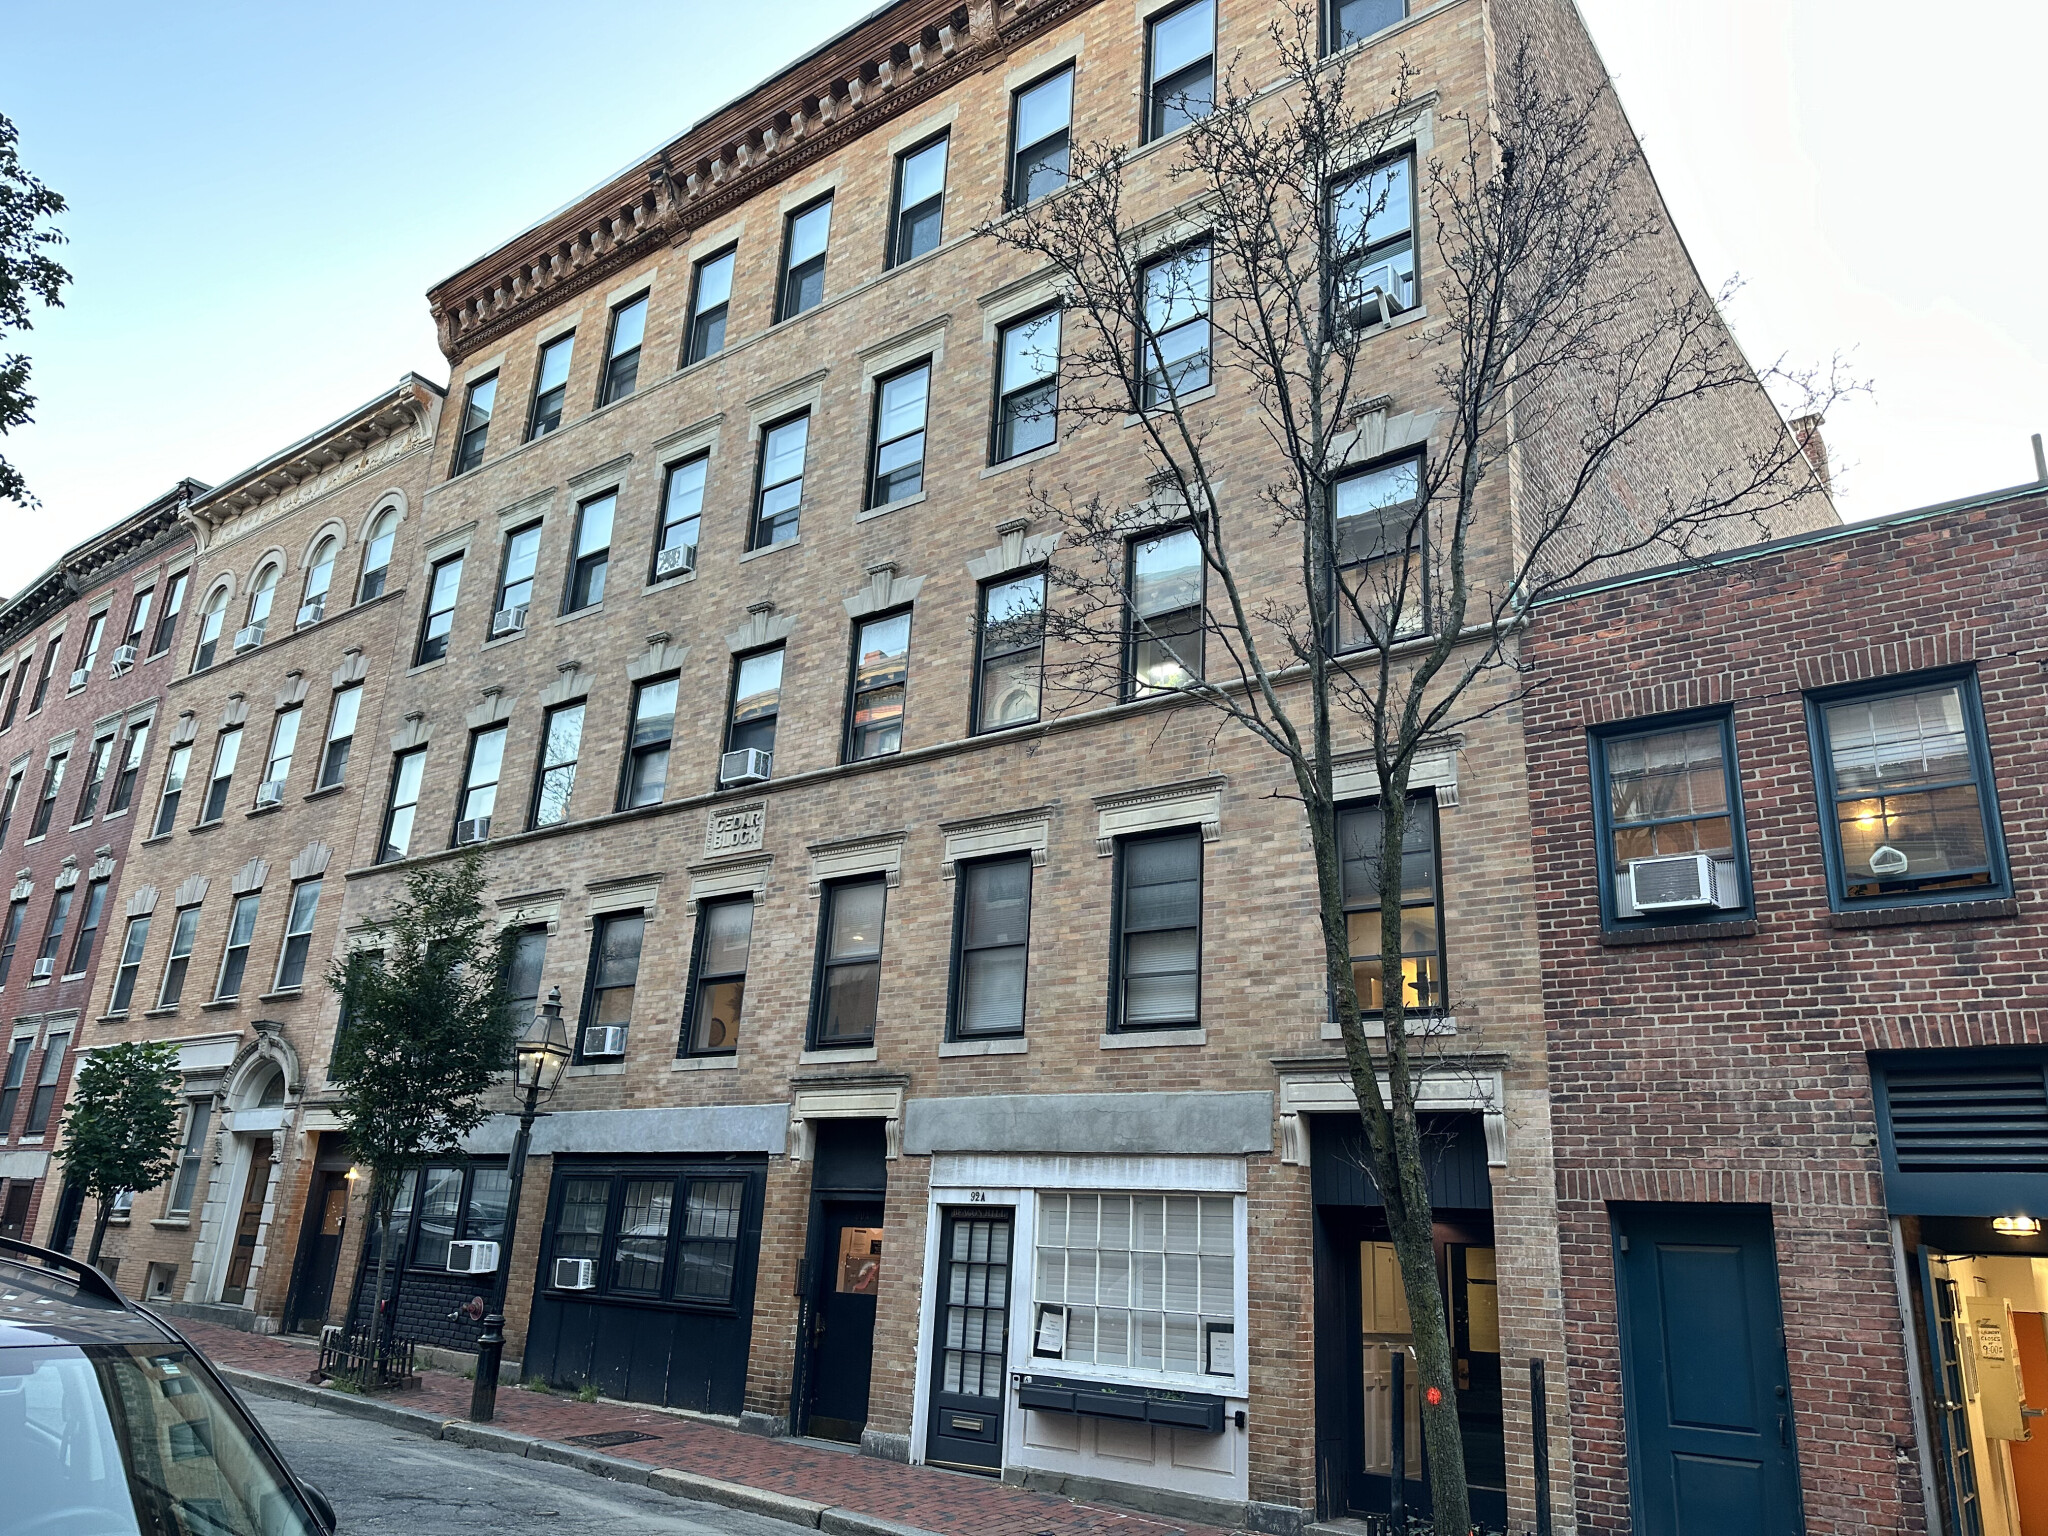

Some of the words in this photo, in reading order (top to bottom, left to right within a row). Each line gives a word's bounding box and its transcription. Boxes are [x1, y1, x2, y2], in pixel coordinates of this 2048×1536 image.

[716, 811, 761, 833] CEDAR
[713, 827, 760, 849] BLOCK
[970, 1191, 986, 1202] 92A
